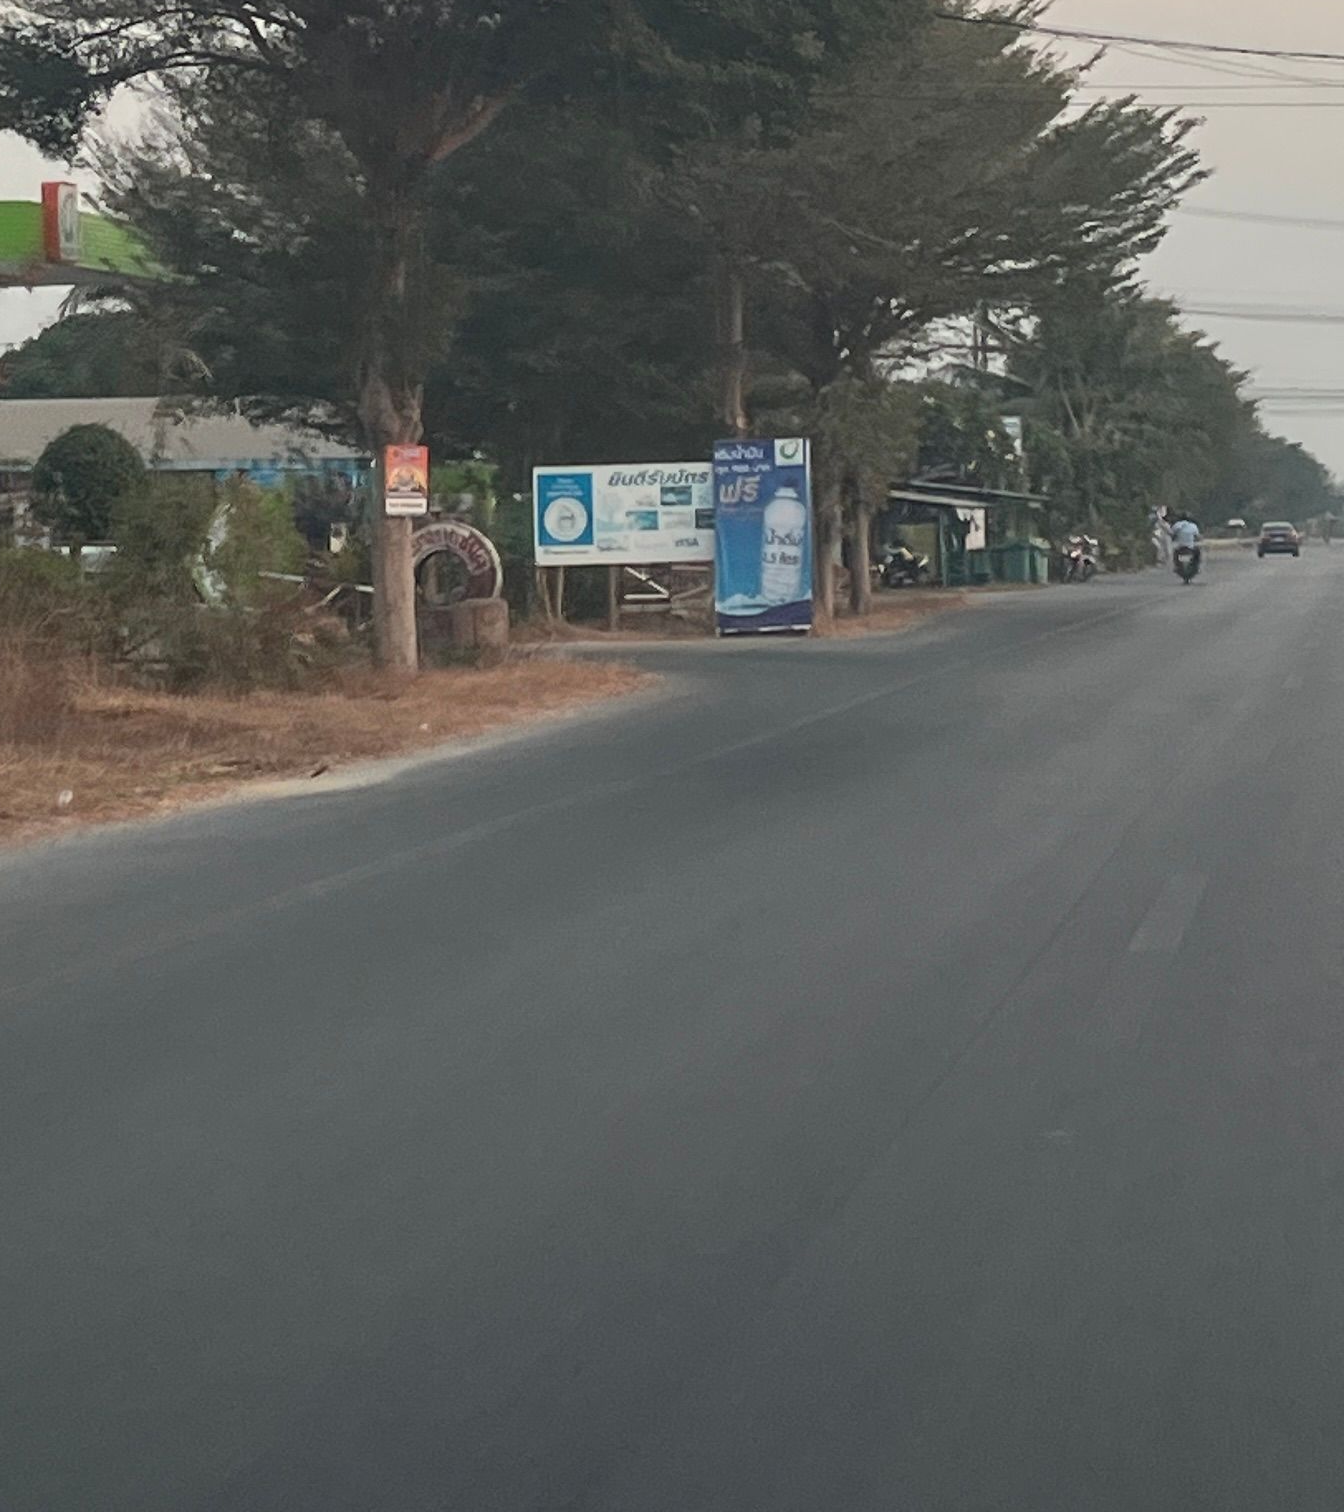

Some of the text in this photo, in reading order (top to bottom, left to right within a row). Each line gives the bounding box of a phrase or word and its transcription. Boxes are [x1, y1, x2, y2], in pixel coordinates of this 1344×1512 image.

[608, 468, 710, 487] ยินดีรับบัตร
[719, 474, 762, 504] ฟรี
